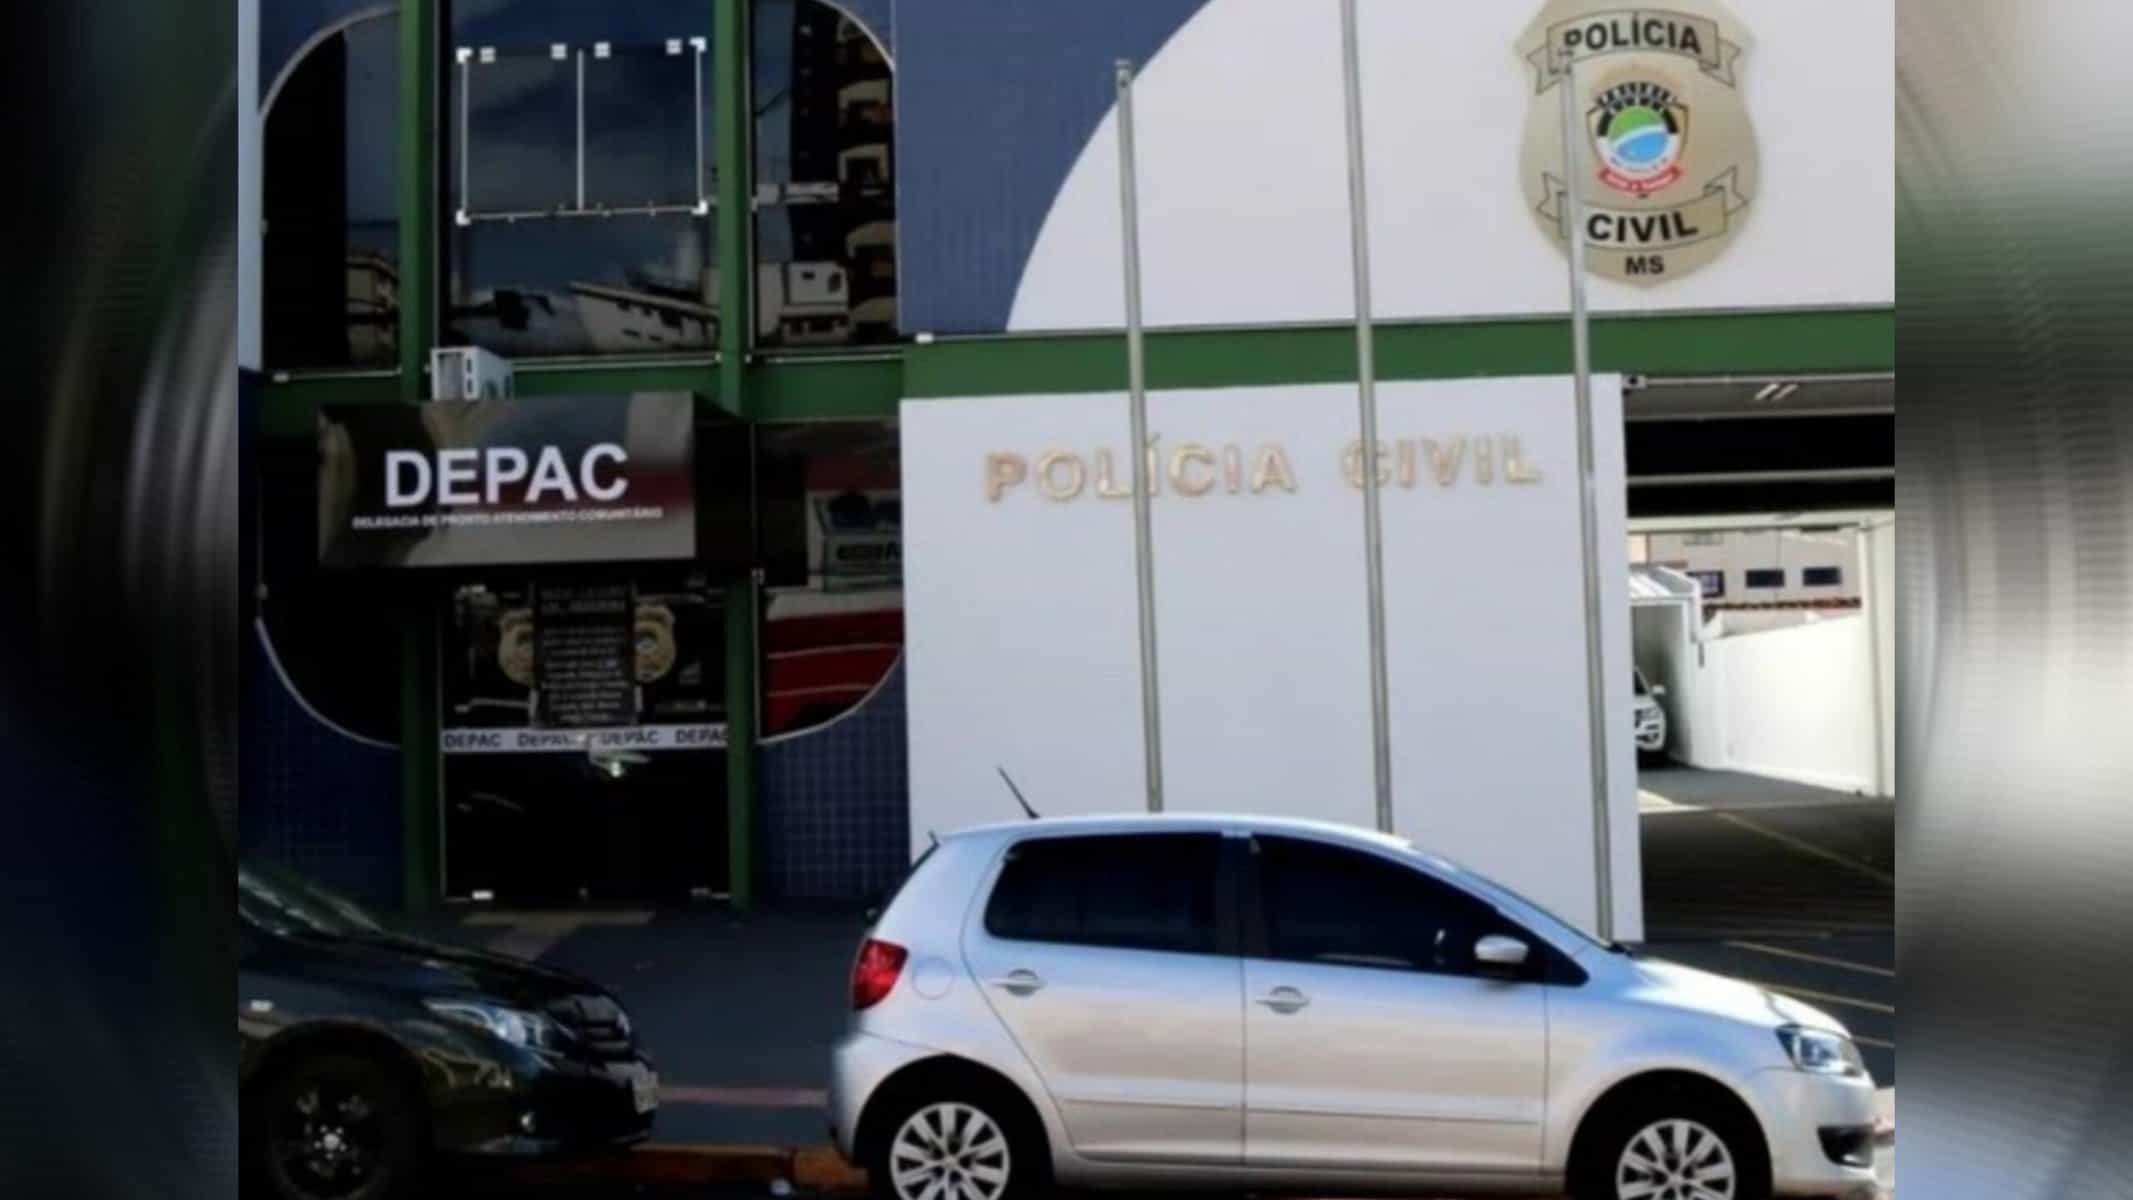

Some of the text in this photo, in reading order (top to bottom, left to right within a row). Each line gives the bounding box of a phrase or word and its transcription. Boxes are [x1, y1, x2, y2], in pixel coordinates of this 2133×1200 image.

[1564, 12, 1702, 54] POLÍCIA
[1587, 211, 1698, 243] CIVIL
[1625, 256, 1664, 275] MS
[384, 443, 629, 508] DEPAC
[984, 432, 1544, 503] POLÍCIA CIVIL
[352, 506, 664, 529] DELEGACIA DE PRONTO ATENDIMENTO COMUNITÁRIO
[445, 731, 501, 747] DEPAC
